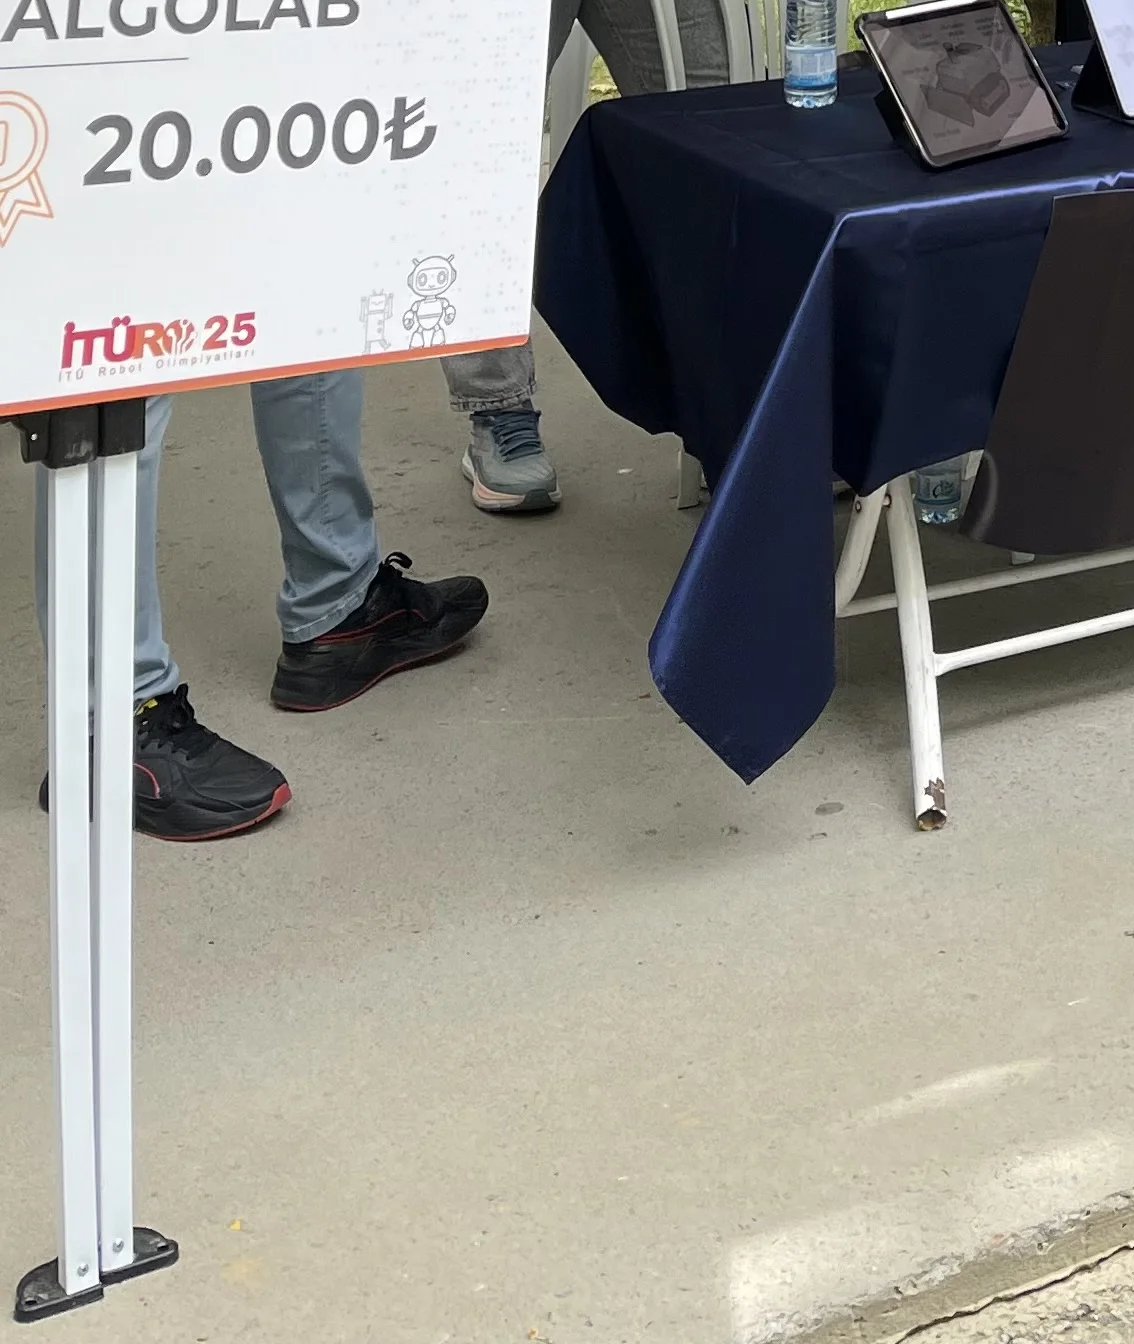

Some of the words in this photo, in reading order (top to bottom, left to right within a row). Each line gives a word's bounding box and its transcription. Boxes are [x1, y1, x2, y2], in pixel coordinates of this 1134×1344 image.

[82, 96, 438, 187] 20.000₺
[202, 311, 257, 351] 25
[58, 369, 84, 383] İTÜ
[98, 363, 143, 378] Robot
[154, 348, 256, 370] Olimpiyatları
